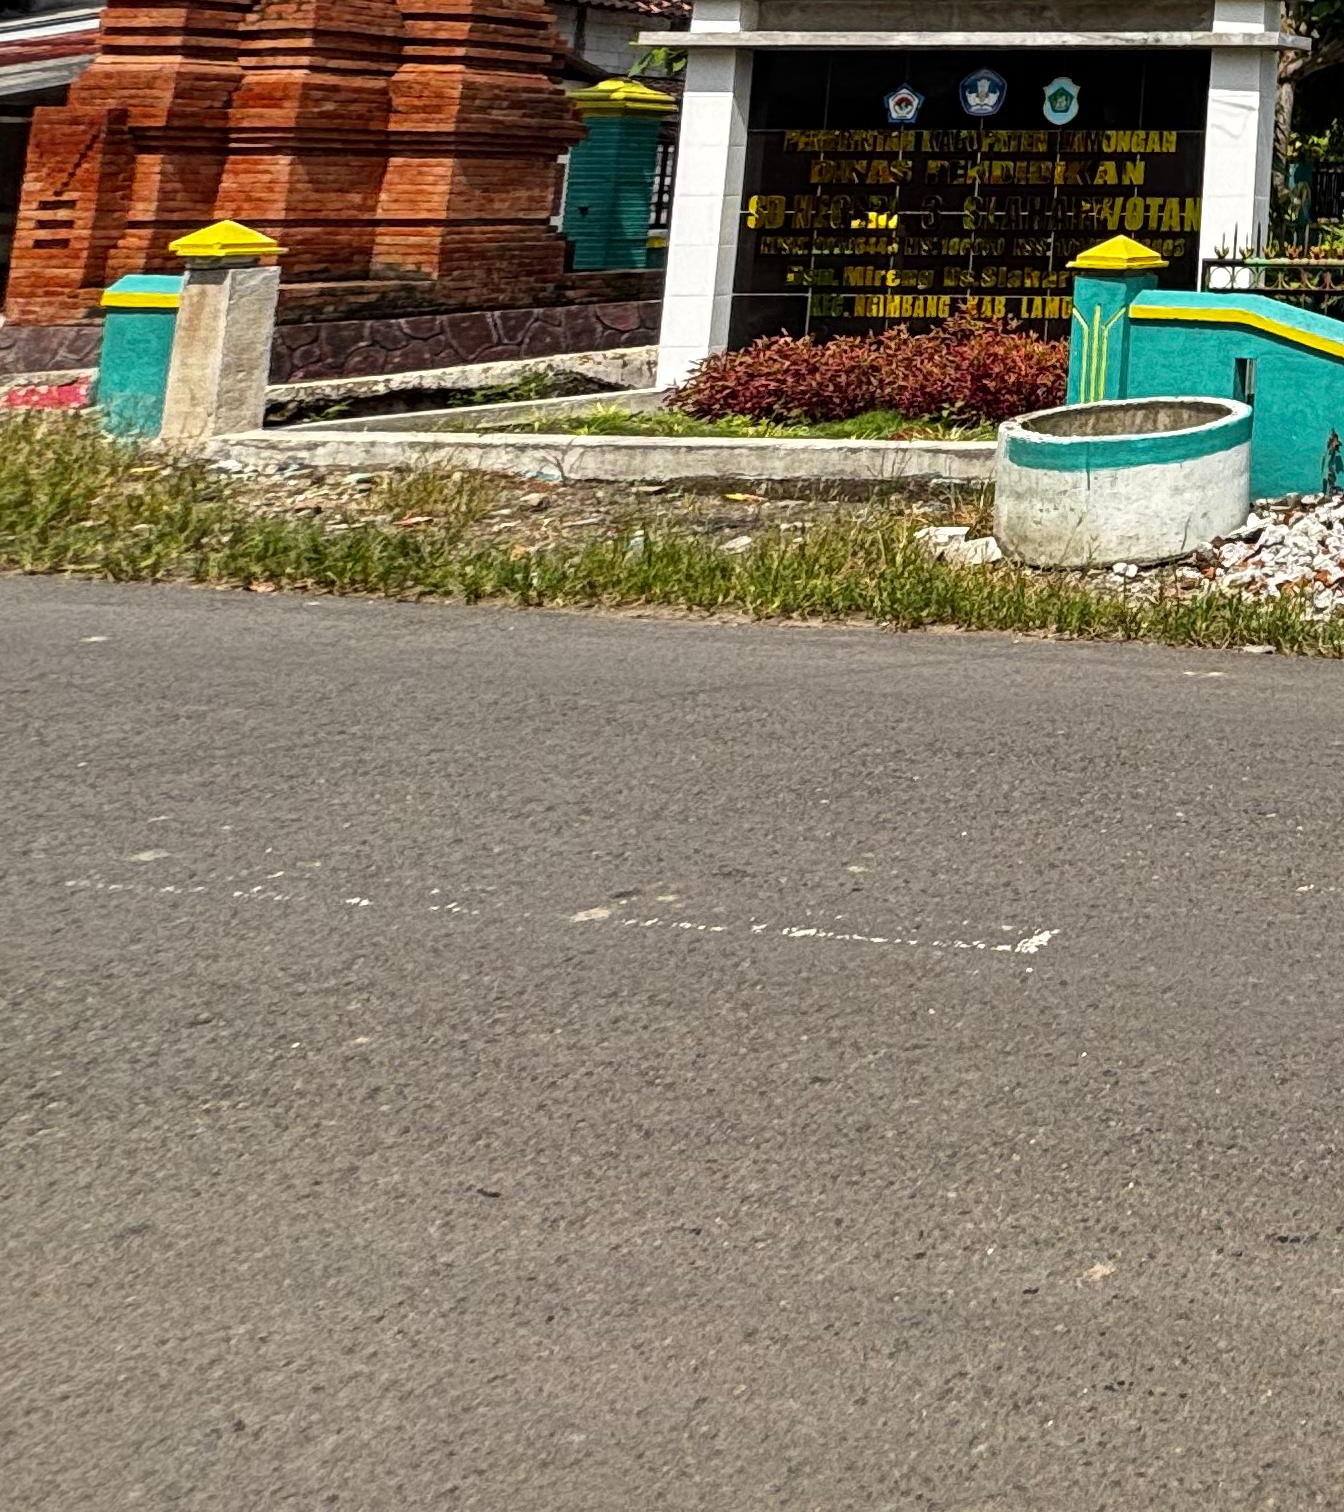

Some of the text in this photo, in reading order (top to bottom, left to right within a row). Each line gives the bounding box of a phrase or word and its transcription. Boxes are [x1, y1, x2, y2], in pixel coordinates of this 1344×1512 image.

[1059, 130, 1177, 152] LAMONGAN
[809, 160, 1146, 185] DINAS PENDIDIKAN
[747, 194, 787, 230] SD
[853, 295, 951, 319] NGIMBANG
[1020, 295, 1073, 320] LAMO
